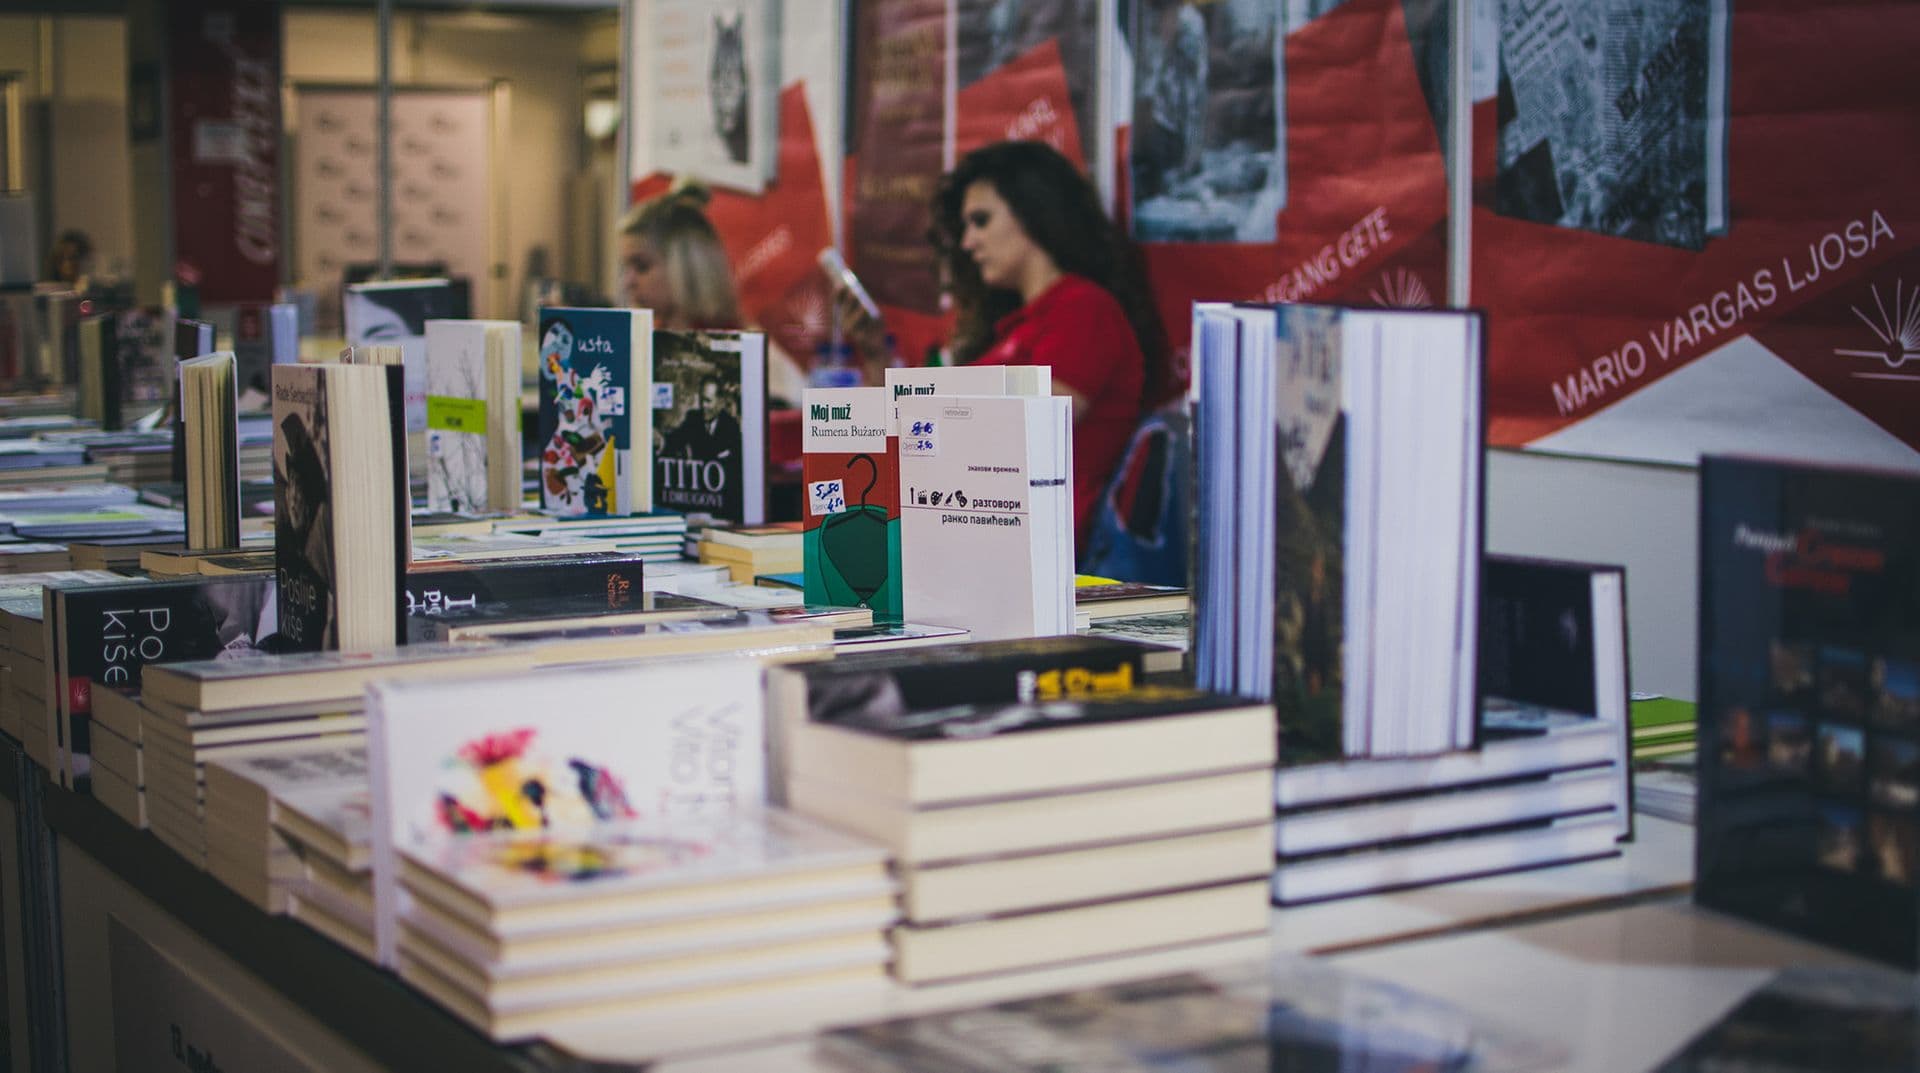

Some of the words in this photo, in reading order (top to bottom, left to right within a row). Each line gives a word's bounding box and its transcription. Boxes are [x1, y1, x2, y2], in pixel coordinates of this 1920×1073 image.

[1338, 206, 1393, 268] GETE
[1552, 341, 1647, 417] MARIO
[1650, 269, 1777, 361] VARGAS
[1782, 210, 1895, 292] LJOSA
[577, 336, 613, 354] usta
[810, 404, 829, 421] Moj
[831, 403, 851, 420] muž
[811, 425, 848, 437] Rumena
[658, 457, 725, 492] TITO
[942, 513, 968, 526] ранко
[970, 514, 1021, 527] павићевић
[973, 497, 1021, 509] разговори
[281, 567, 316, 615] Poslije
[103, 609, 137, 682] kiše
[139, 608, 170, 659] Po
